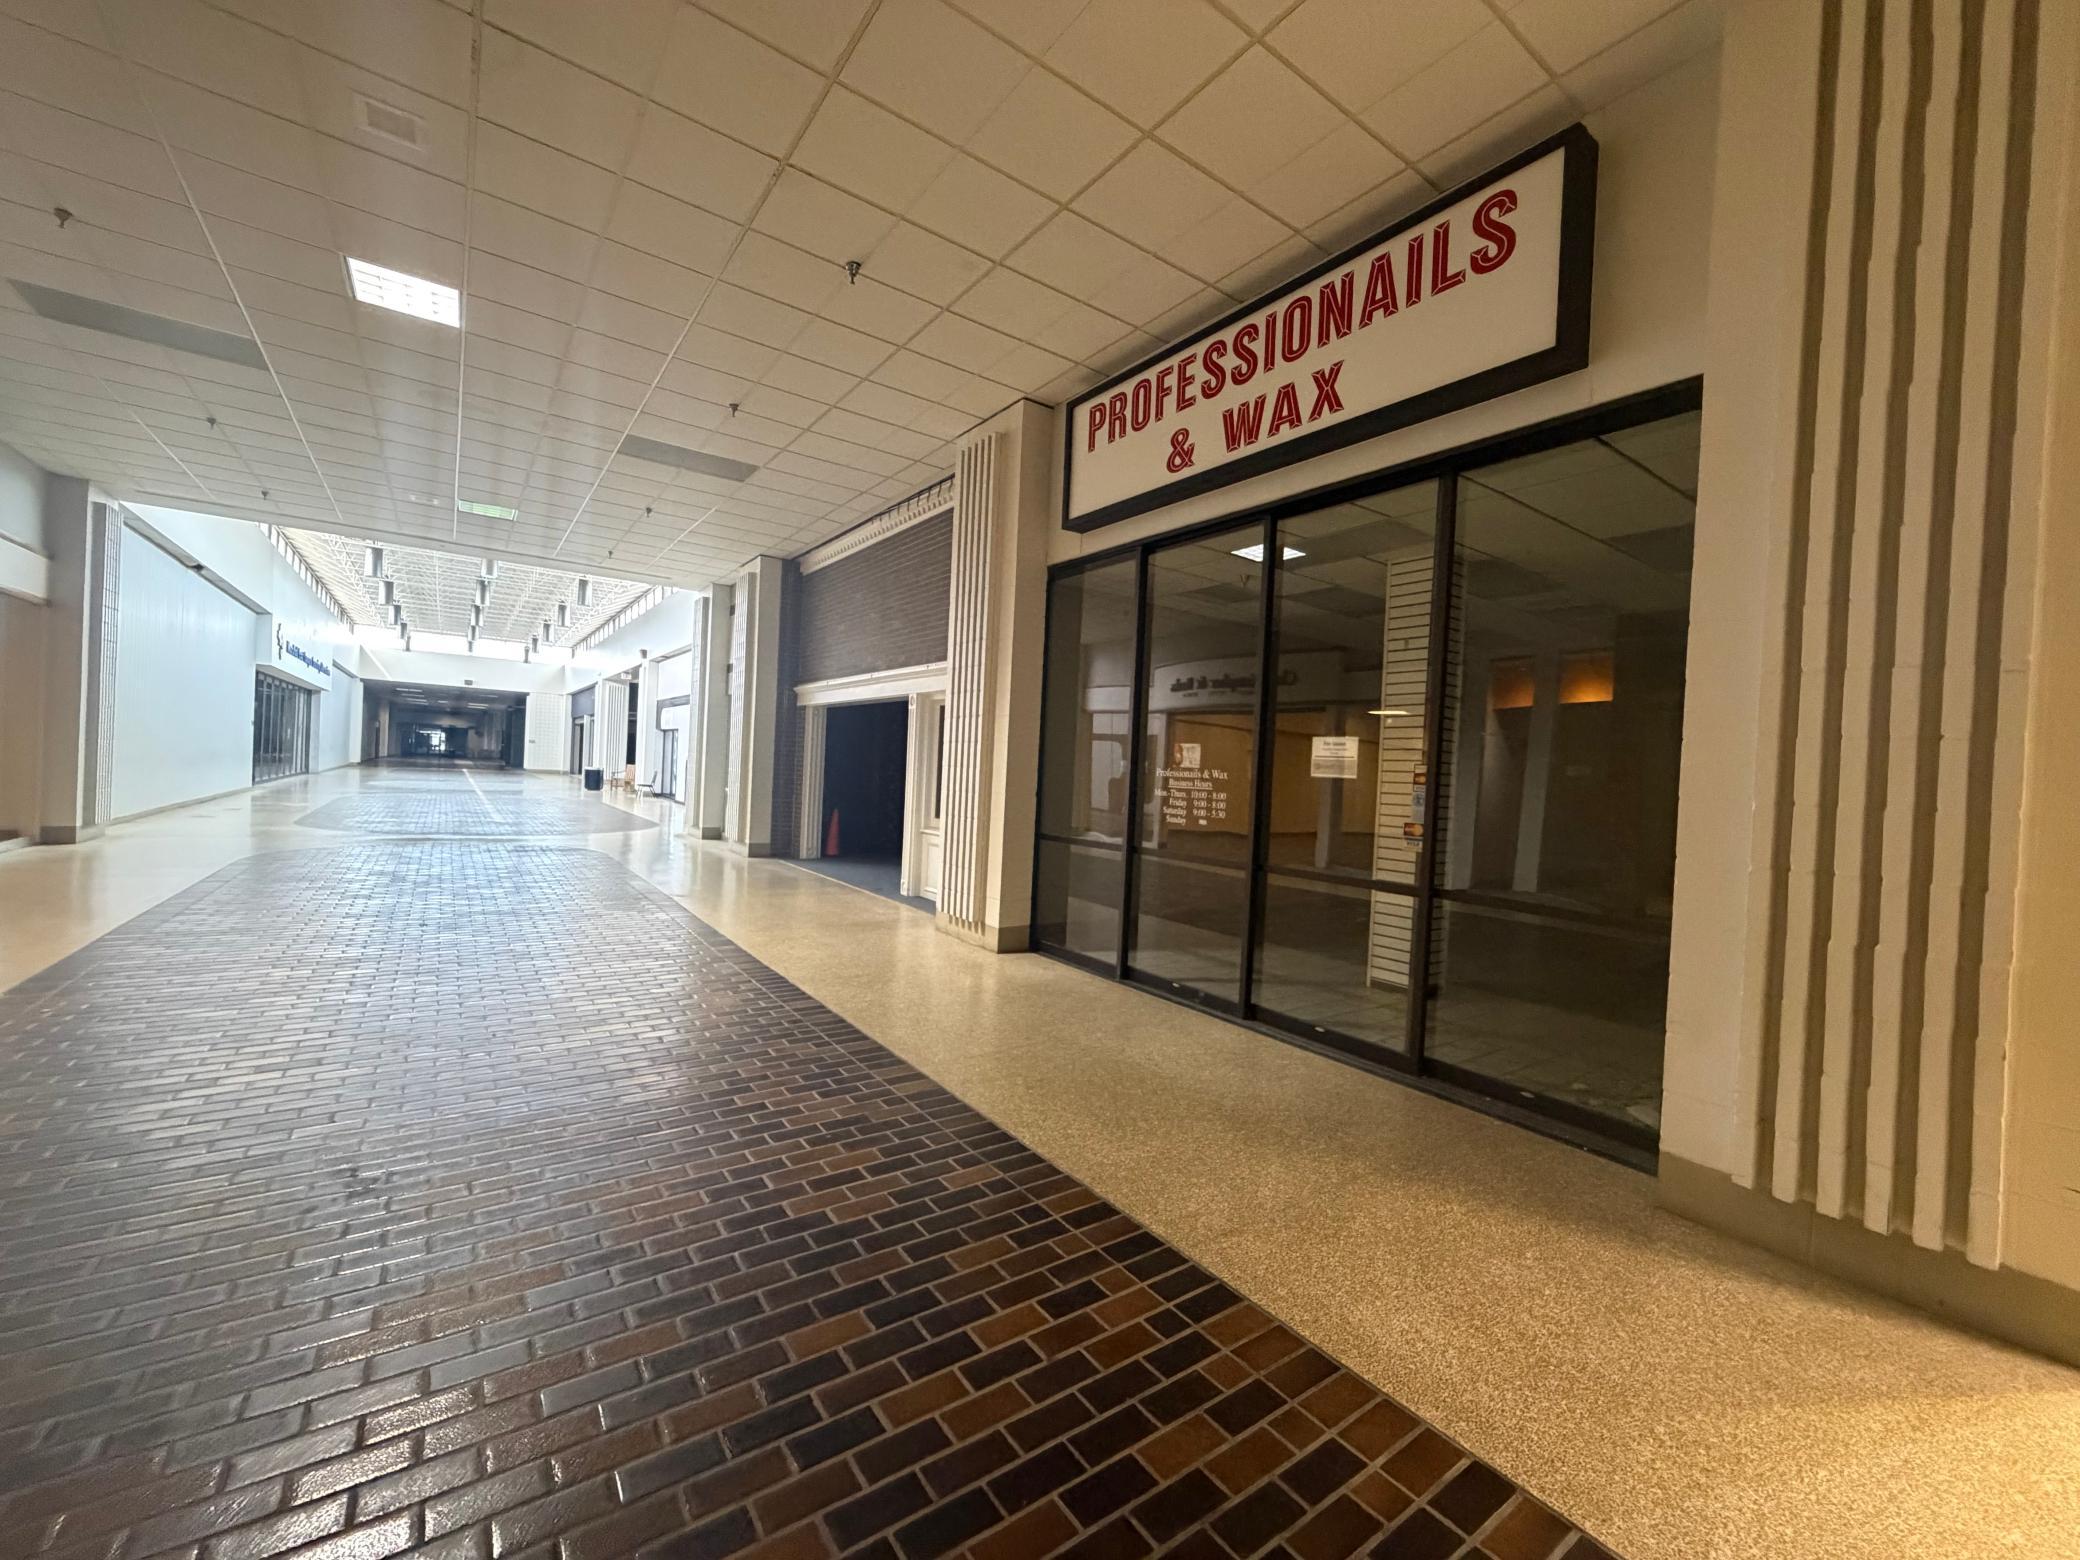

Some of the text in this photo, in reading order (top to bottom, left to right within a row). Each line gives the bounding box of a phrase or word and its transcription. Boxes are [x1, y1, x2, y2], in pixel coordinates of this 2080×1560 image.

[1088, 189, 1518, 453] PROFESSIONAILS
[1166, 360, 1344, 474] & WAX
[1203, 769, 1210, 779] &
[1212, 769, 1228, 780] Wax
[1194, 779, 1213, 789] Hours
[1169, 798, 1187, 808] Friday
[1163, 806, 1187, 817] Saturday
[1166, 815, 1186, 826] Sunday
